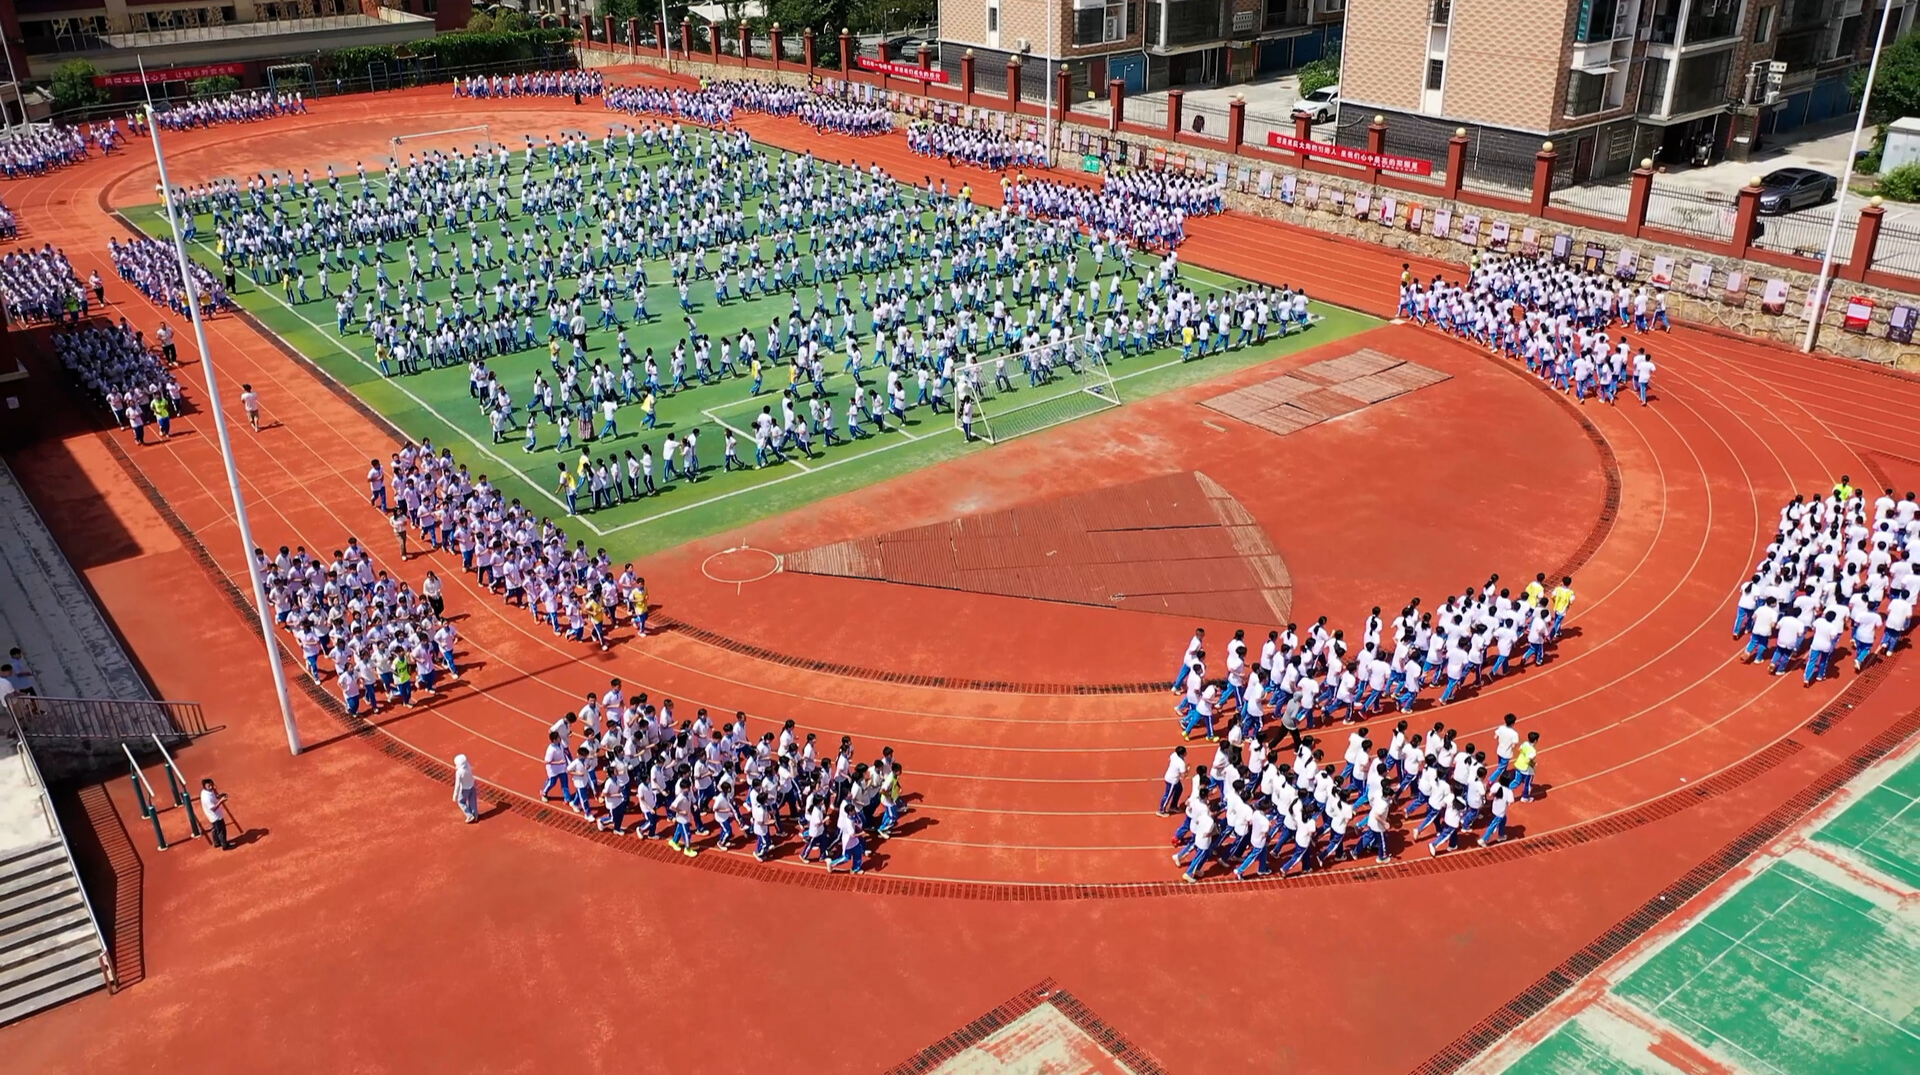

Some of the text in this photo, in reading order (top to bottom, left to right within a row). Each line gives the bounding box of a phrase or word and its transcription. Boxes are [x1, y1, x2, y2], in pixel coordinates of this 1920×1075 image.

[1276, 136, 1337, 156] 您是星辰大海的引路人
